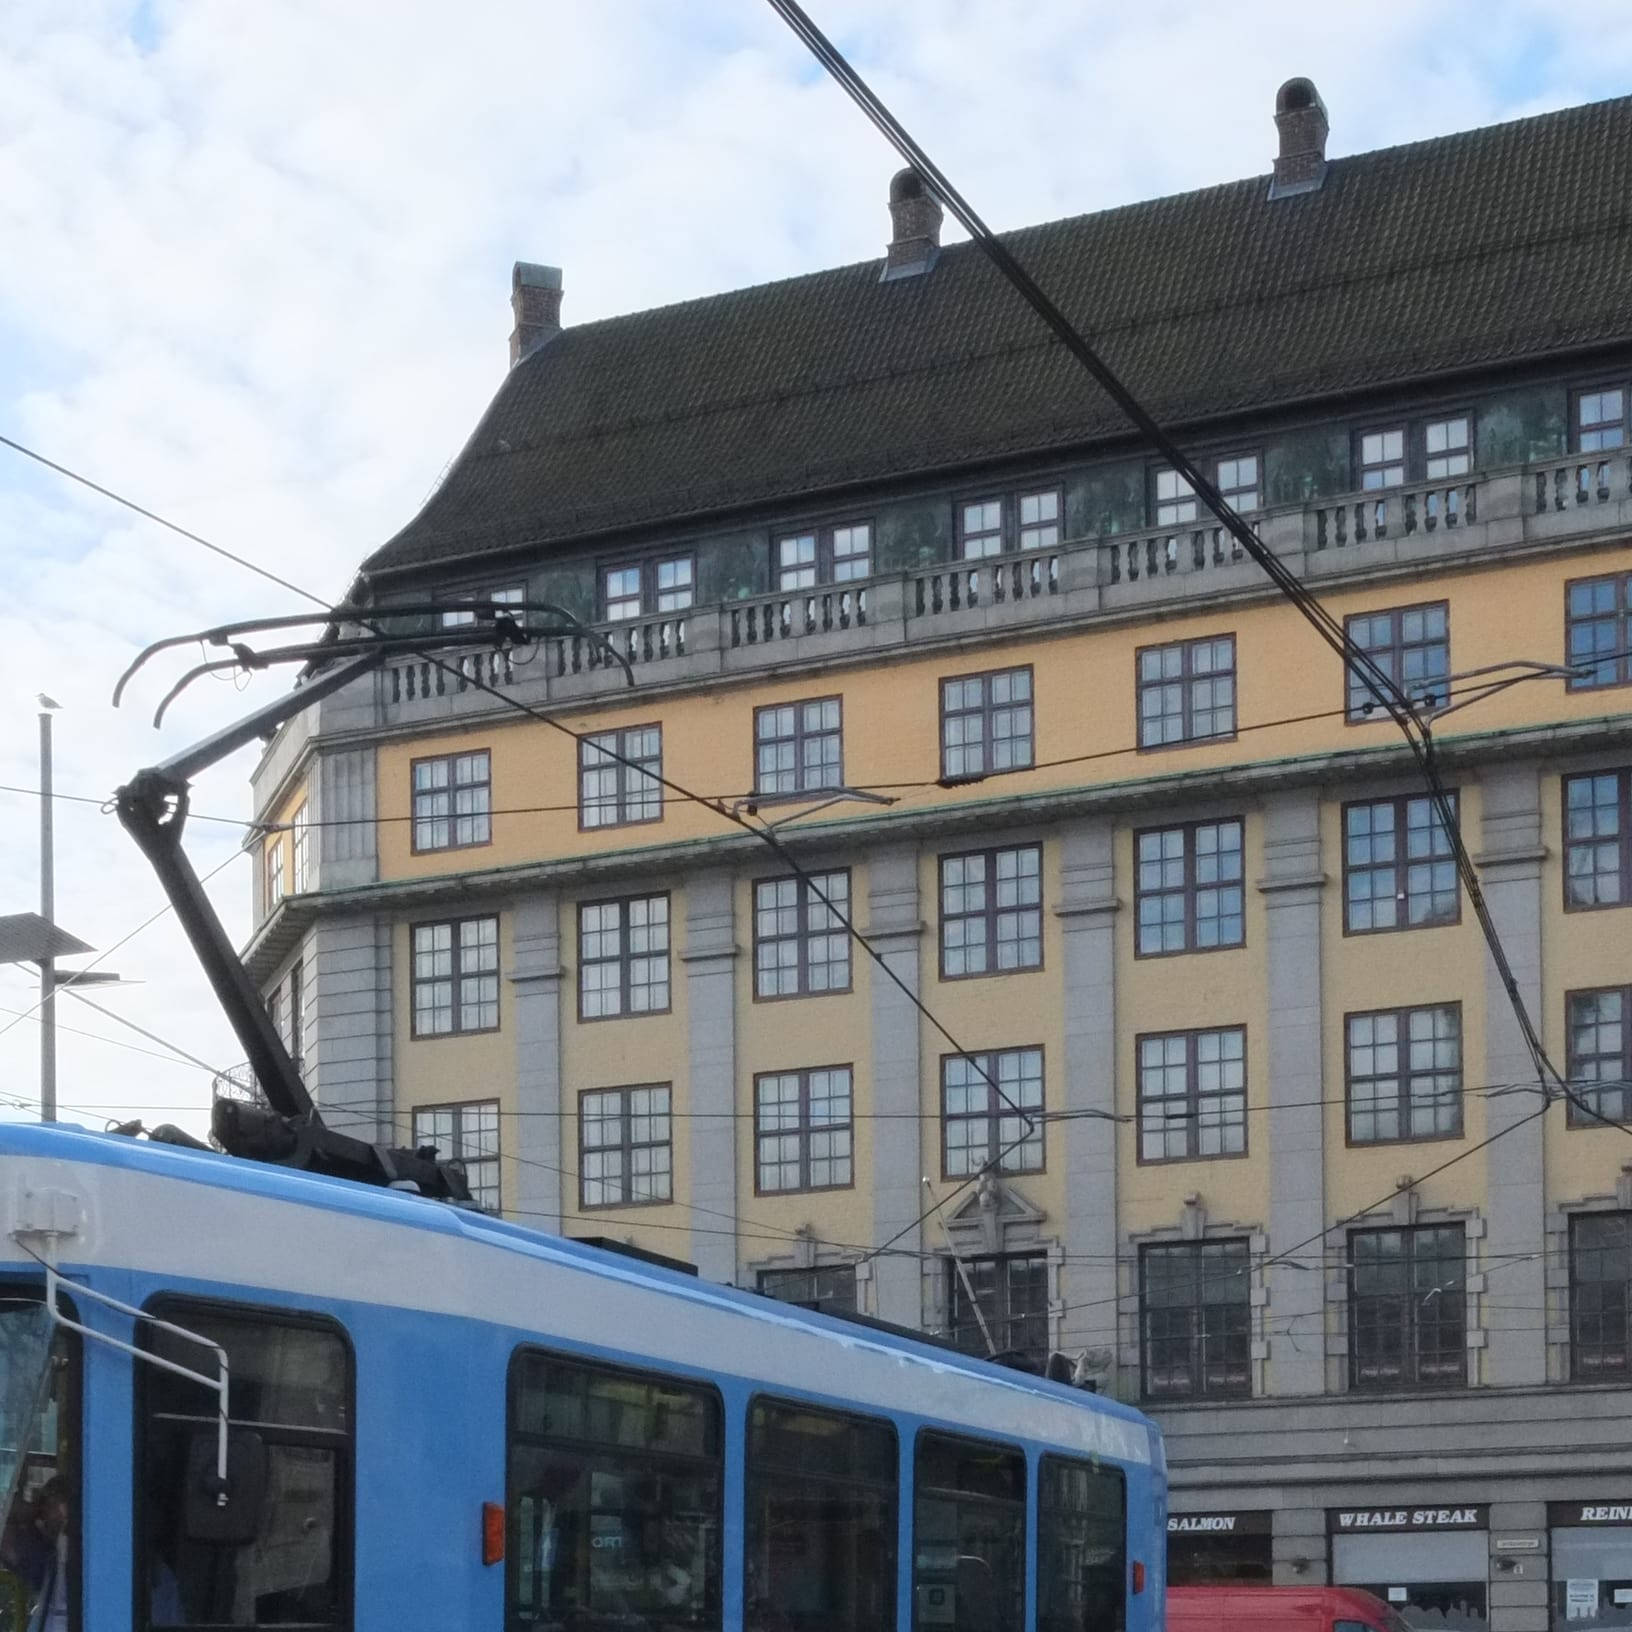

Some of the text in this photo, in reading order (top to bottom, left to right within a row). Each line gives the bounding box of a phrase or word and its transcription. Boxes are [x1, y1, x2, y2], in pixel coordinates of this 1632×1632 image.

[1167, 1517, 1236, 1532] SALMON
[1339, 1509, 1478, 1527] WHALE STEAK
